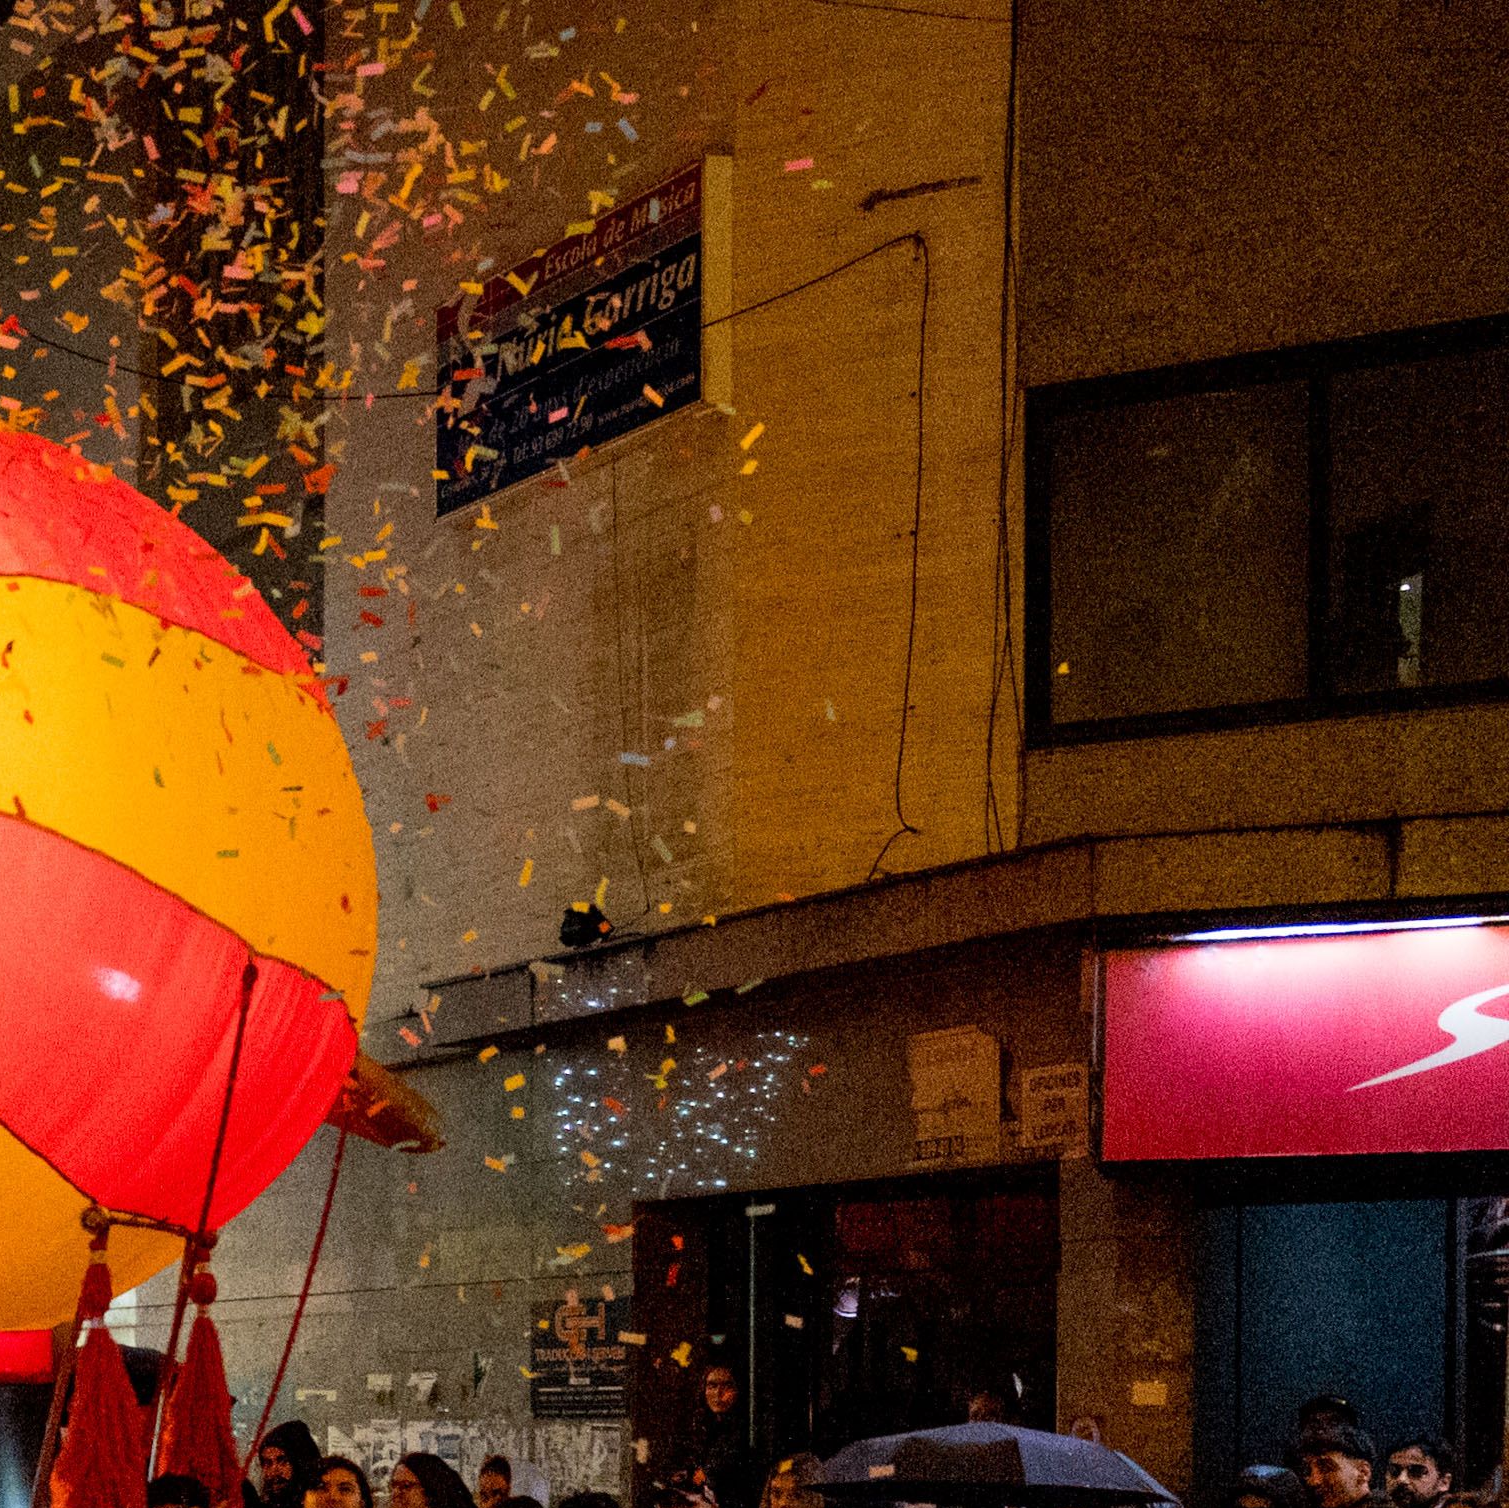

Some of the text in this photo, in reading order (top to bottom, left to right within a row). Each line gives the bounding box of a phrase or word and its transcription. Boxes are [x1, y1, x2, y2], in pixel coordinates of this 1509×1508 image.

[544, 181, 696, 279] Escola de Msica
[583, 253, 697, 336] Garriga
